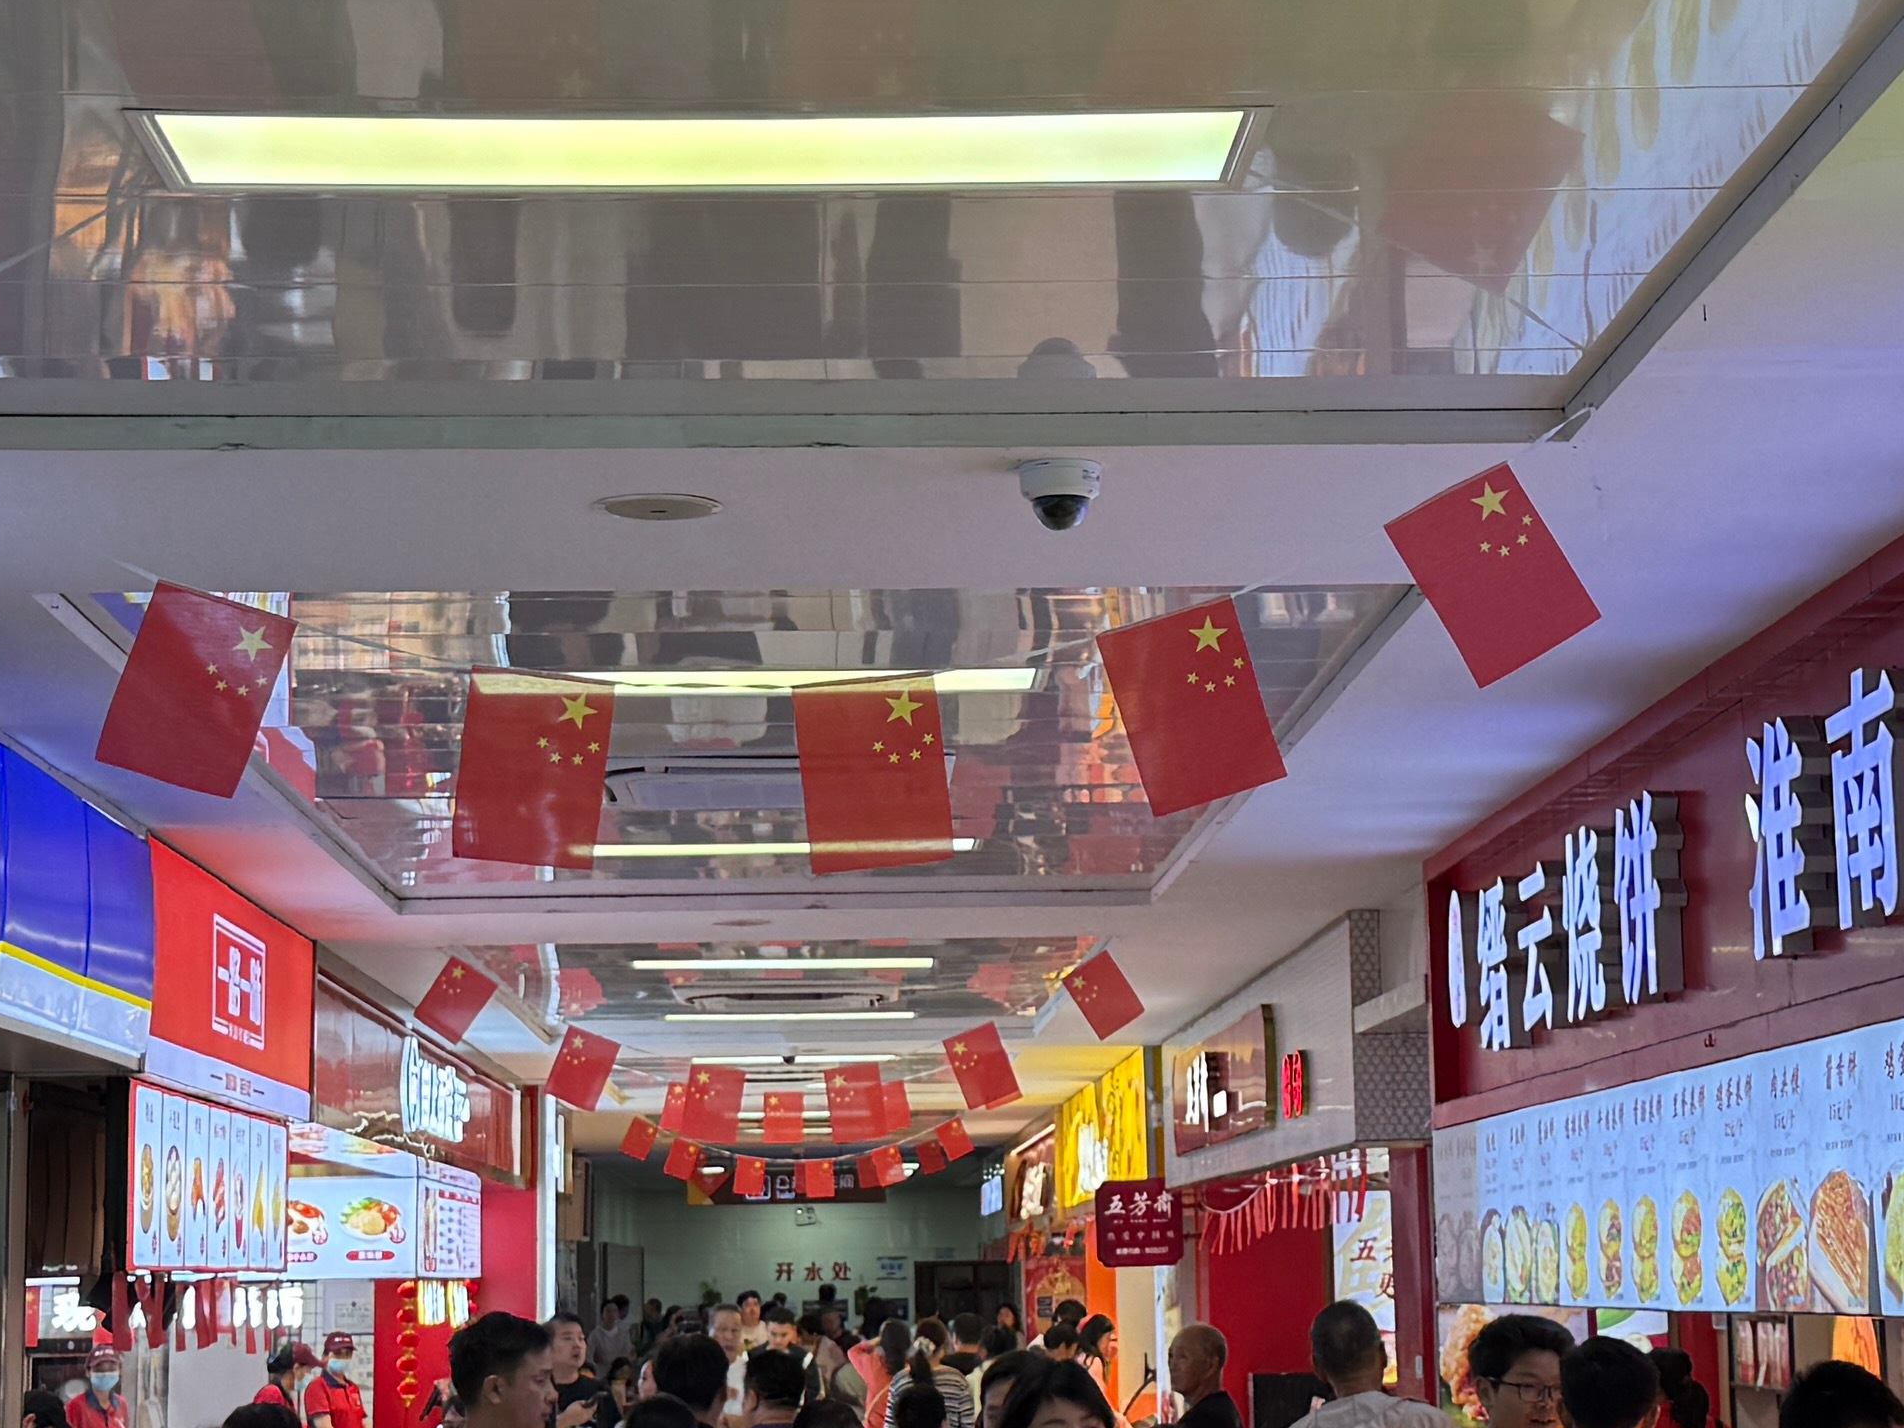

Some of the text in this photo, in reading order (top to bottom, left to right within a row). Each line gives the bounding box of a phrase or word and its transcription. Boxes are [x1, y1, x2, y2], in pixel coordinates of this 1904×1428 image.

[1476, 790, 1661, 1052] 缙云烧饼
[775, 1261, 852, 1282] 开水处
